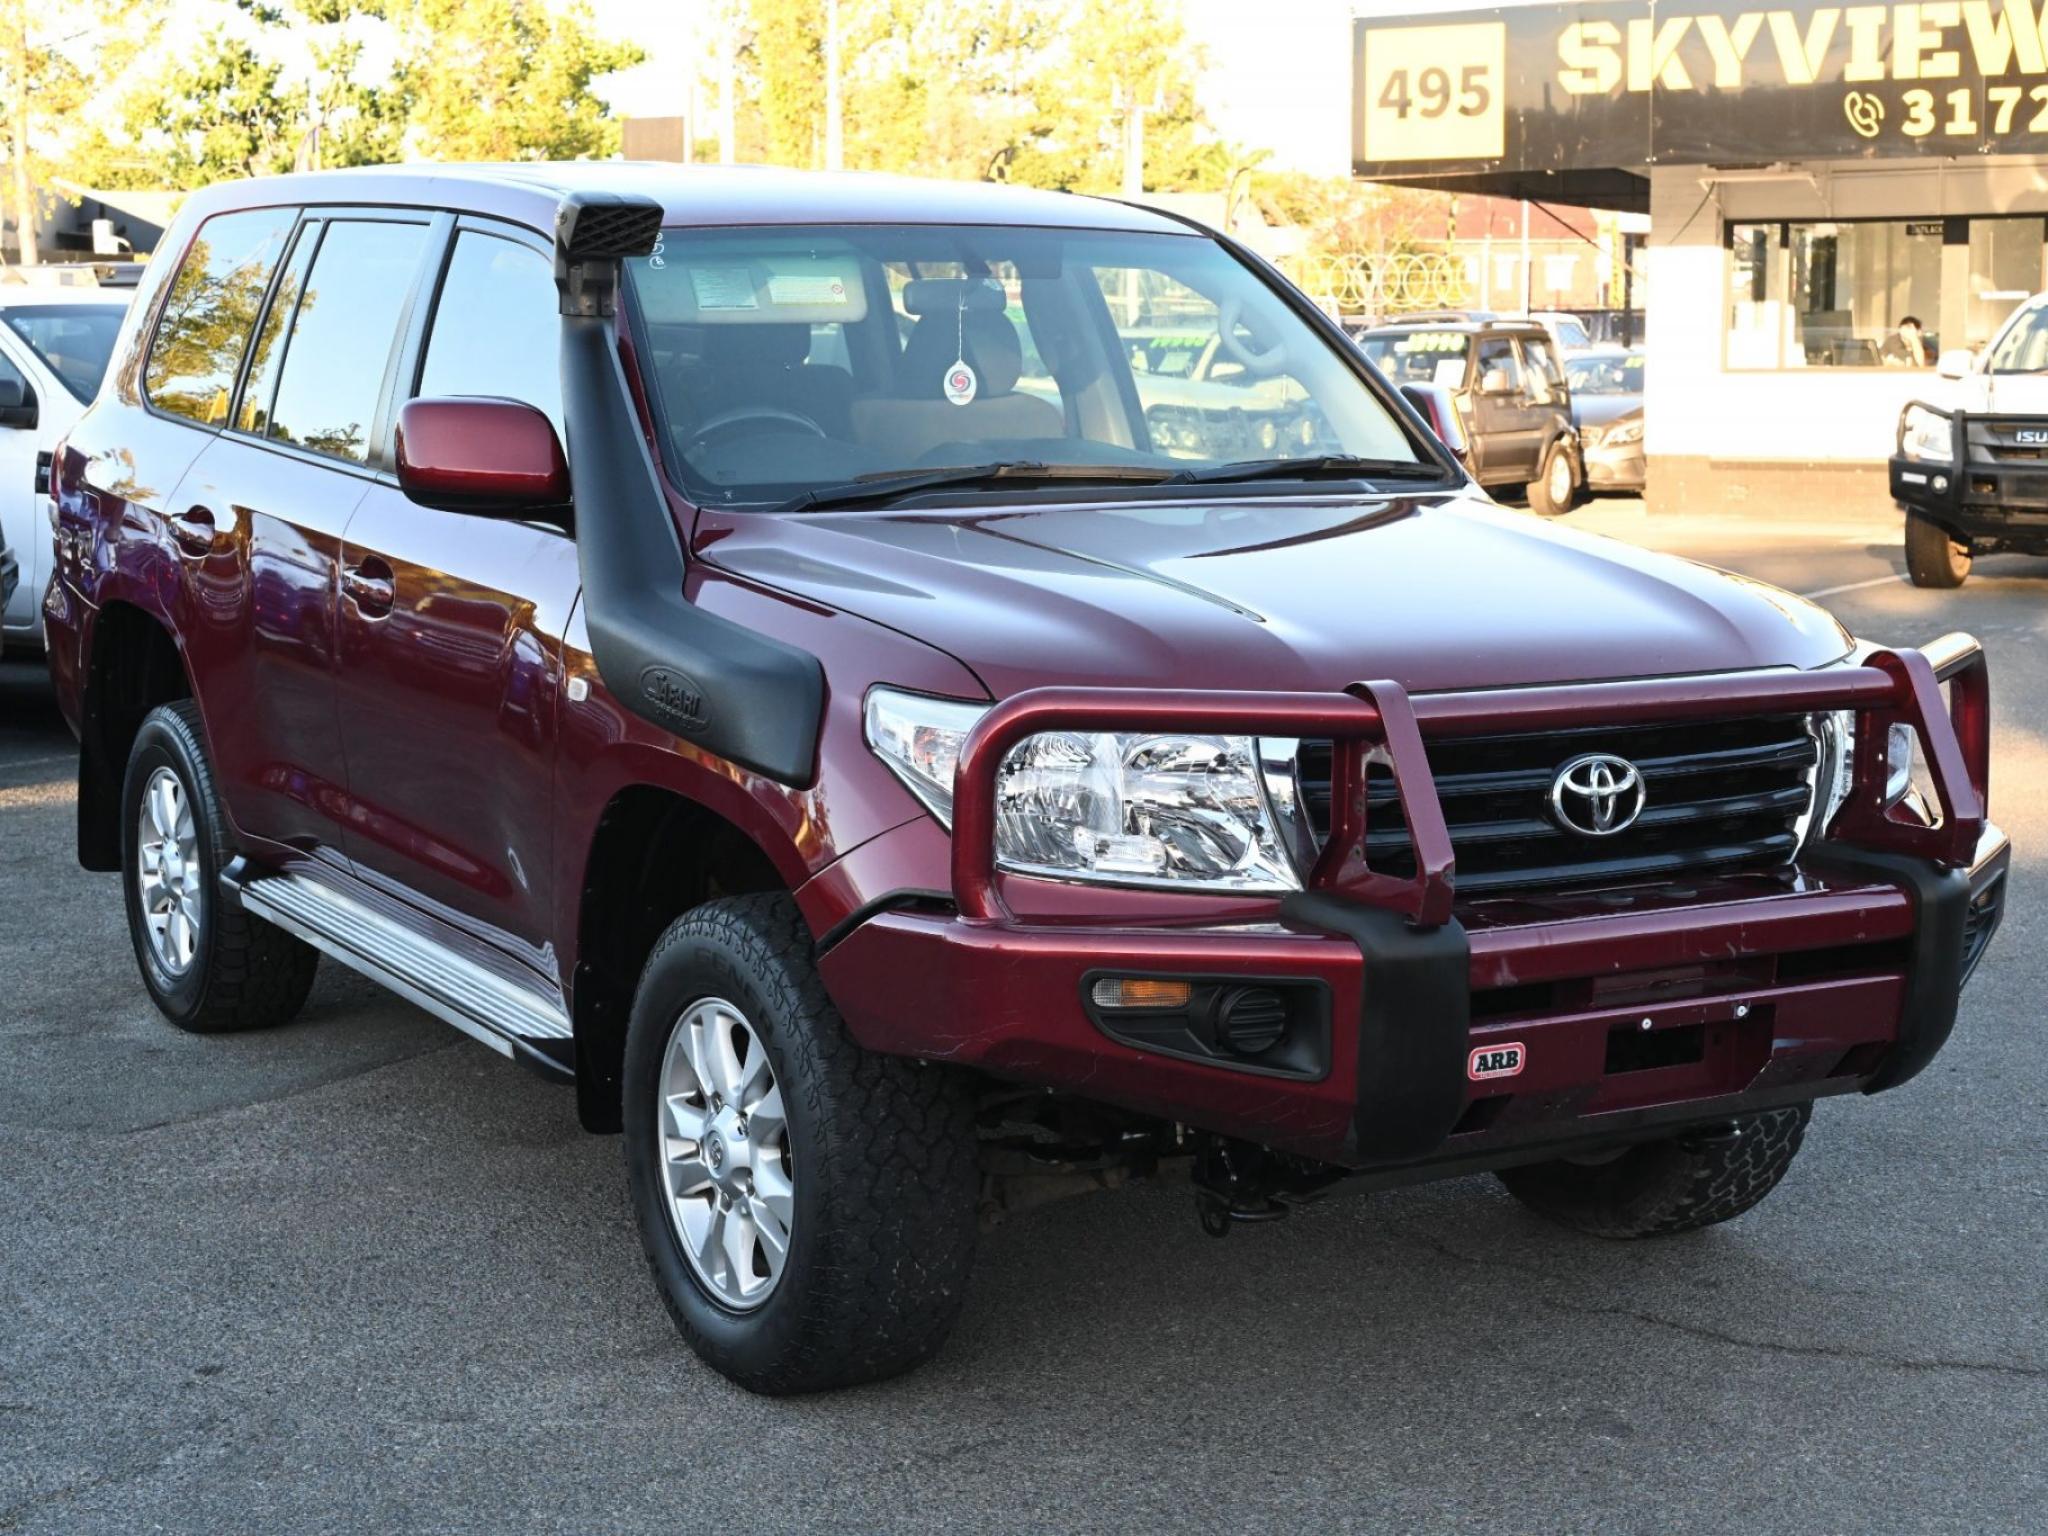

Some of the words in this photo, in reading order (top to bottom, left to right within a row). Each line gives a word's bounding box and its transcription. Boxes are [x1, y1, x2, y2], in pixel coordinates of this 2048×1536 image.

[1558, 0, 2048, 95] SKYVIEW
[1378, 65, 1491, 119] 495
[1901, 84, 2048, 136] 3172
[1475, 1051, 1519, 1073] ARB
